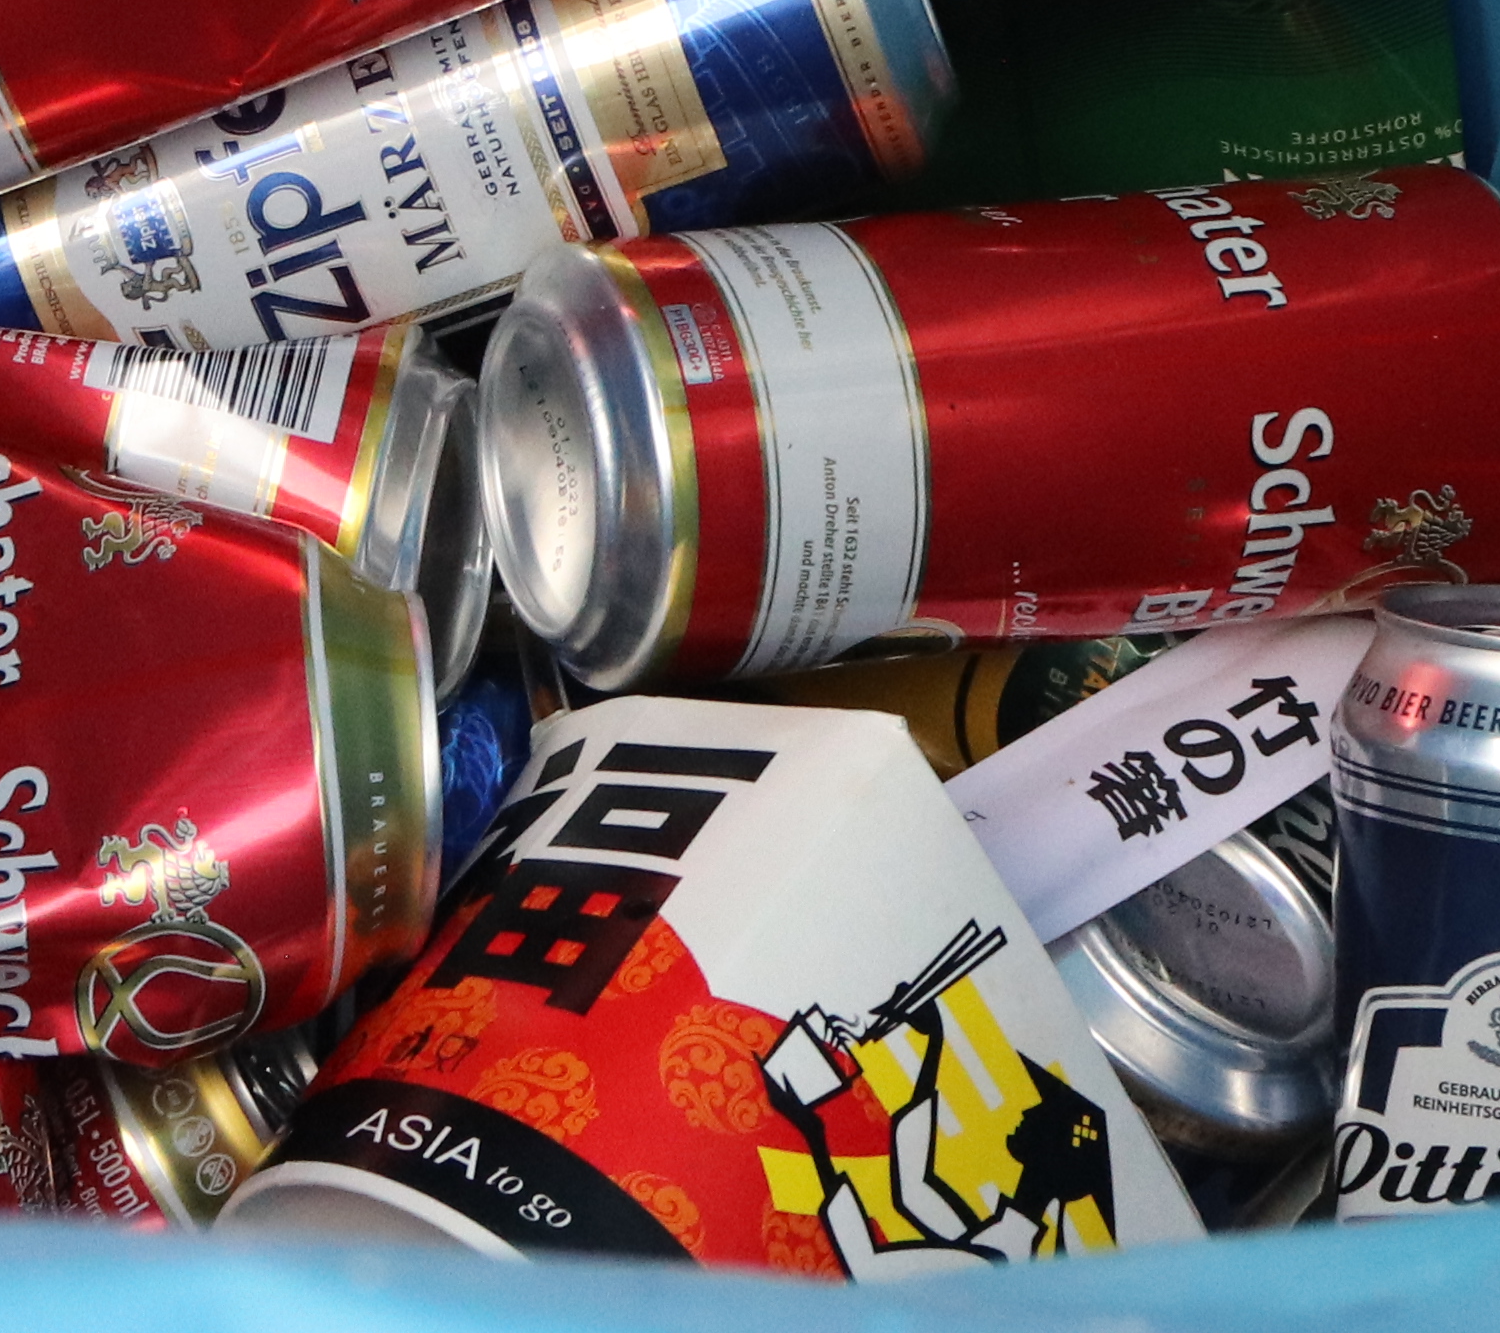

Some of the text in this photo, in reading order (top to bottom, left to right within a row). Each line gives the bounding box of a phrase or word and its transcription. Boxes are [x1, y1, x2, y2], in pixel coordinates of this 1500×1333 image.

[431, 32, 455, 75] MIT
[539, 93, 575, 154] SEIT
[641, 85, 670, 134] GLAS
[1290, 110, 1425, 146] ROHSTOFFE
[1218, 130, 1428, 165] ÖSTERREICHISCHE
[823, 456, 837, 501] Anton
[824, 503, 841, 551] Dreher
[845, 496, 861, 525] Seit
[801, 539, 814, 568] und
[844, 526, 859, 561] 1632
[1381, 685, 1432, 723] BIER
[346, 1105, 574, 1236] ASIA to go
